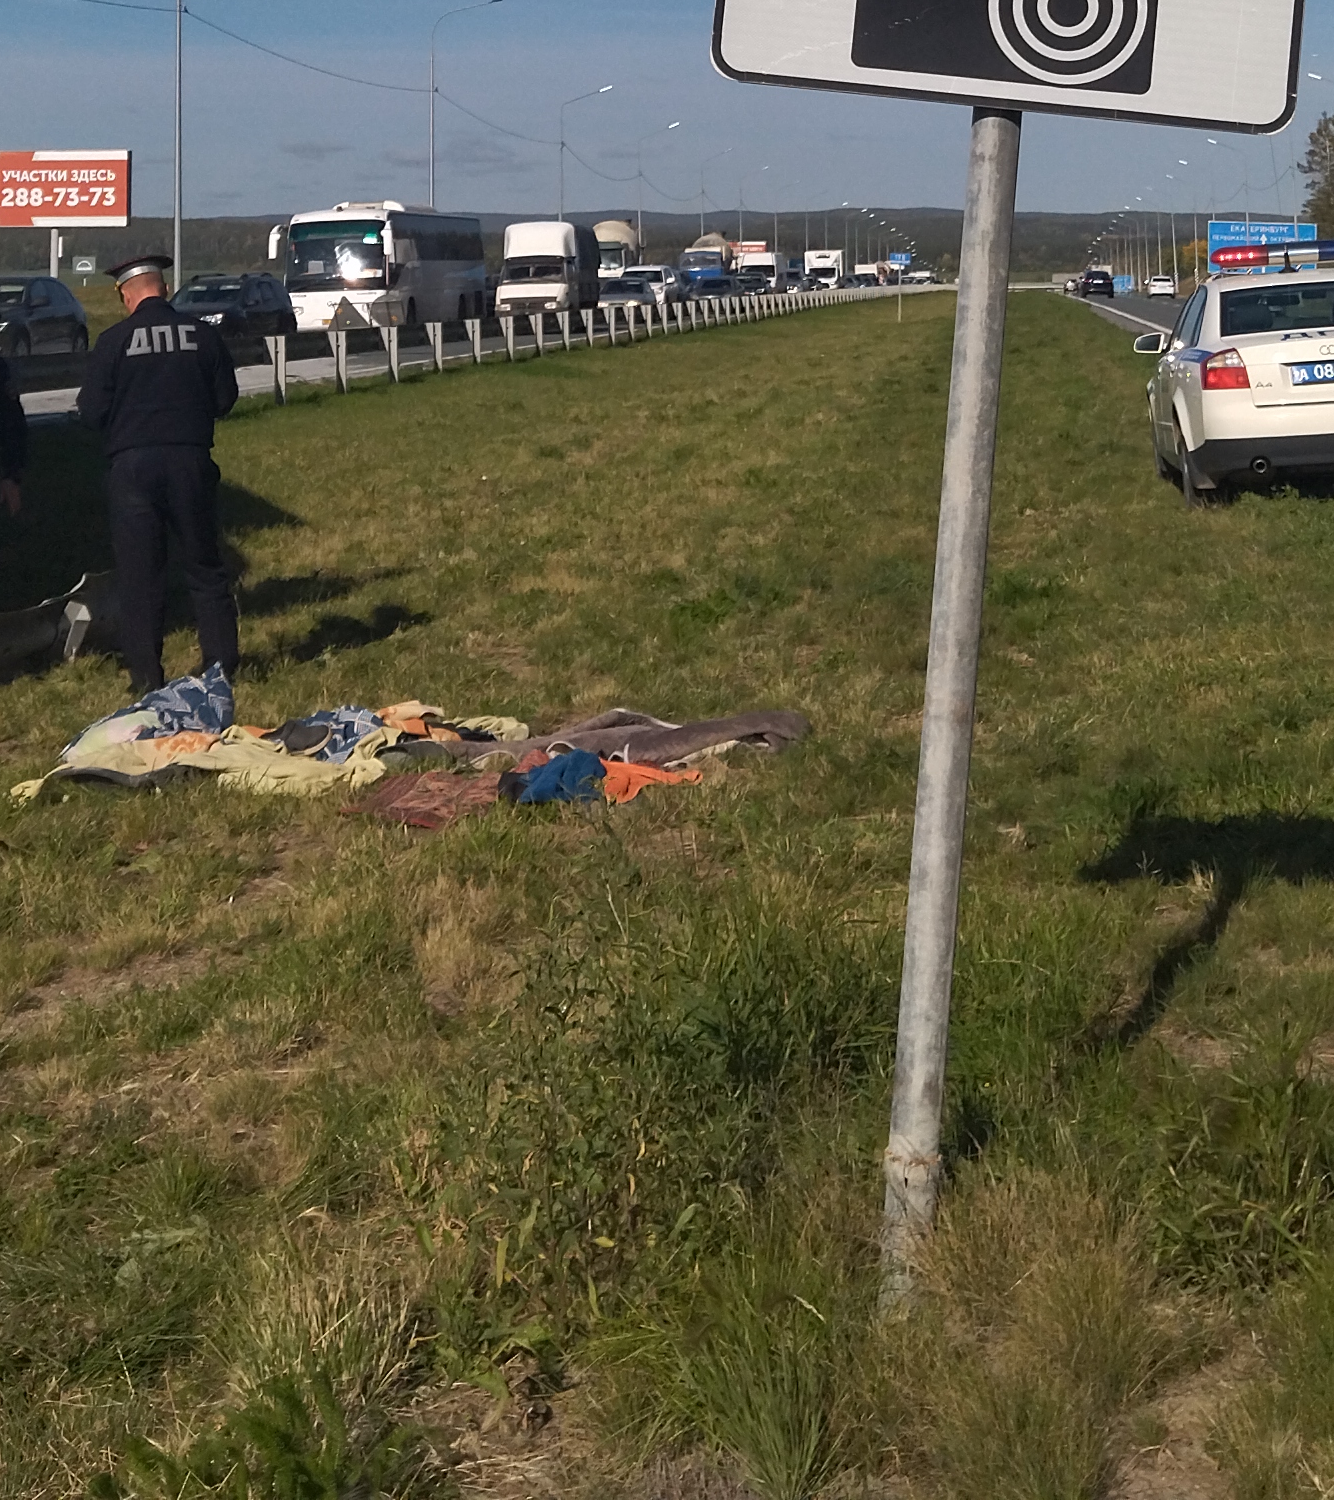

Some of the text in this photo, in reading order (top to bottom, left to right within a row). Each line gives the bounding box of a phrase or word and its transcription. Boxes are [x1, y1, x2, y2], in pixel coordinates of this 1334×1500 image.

[2, 169, 116, 183] УЧАСТКИ ЗДЕСЬ
[1, 187, 116, 207] 288-73-73
[1230, 224, 1289, 233] ЕКАЕРИНБУРГ
[126, 325, 198, 356] ДПС
